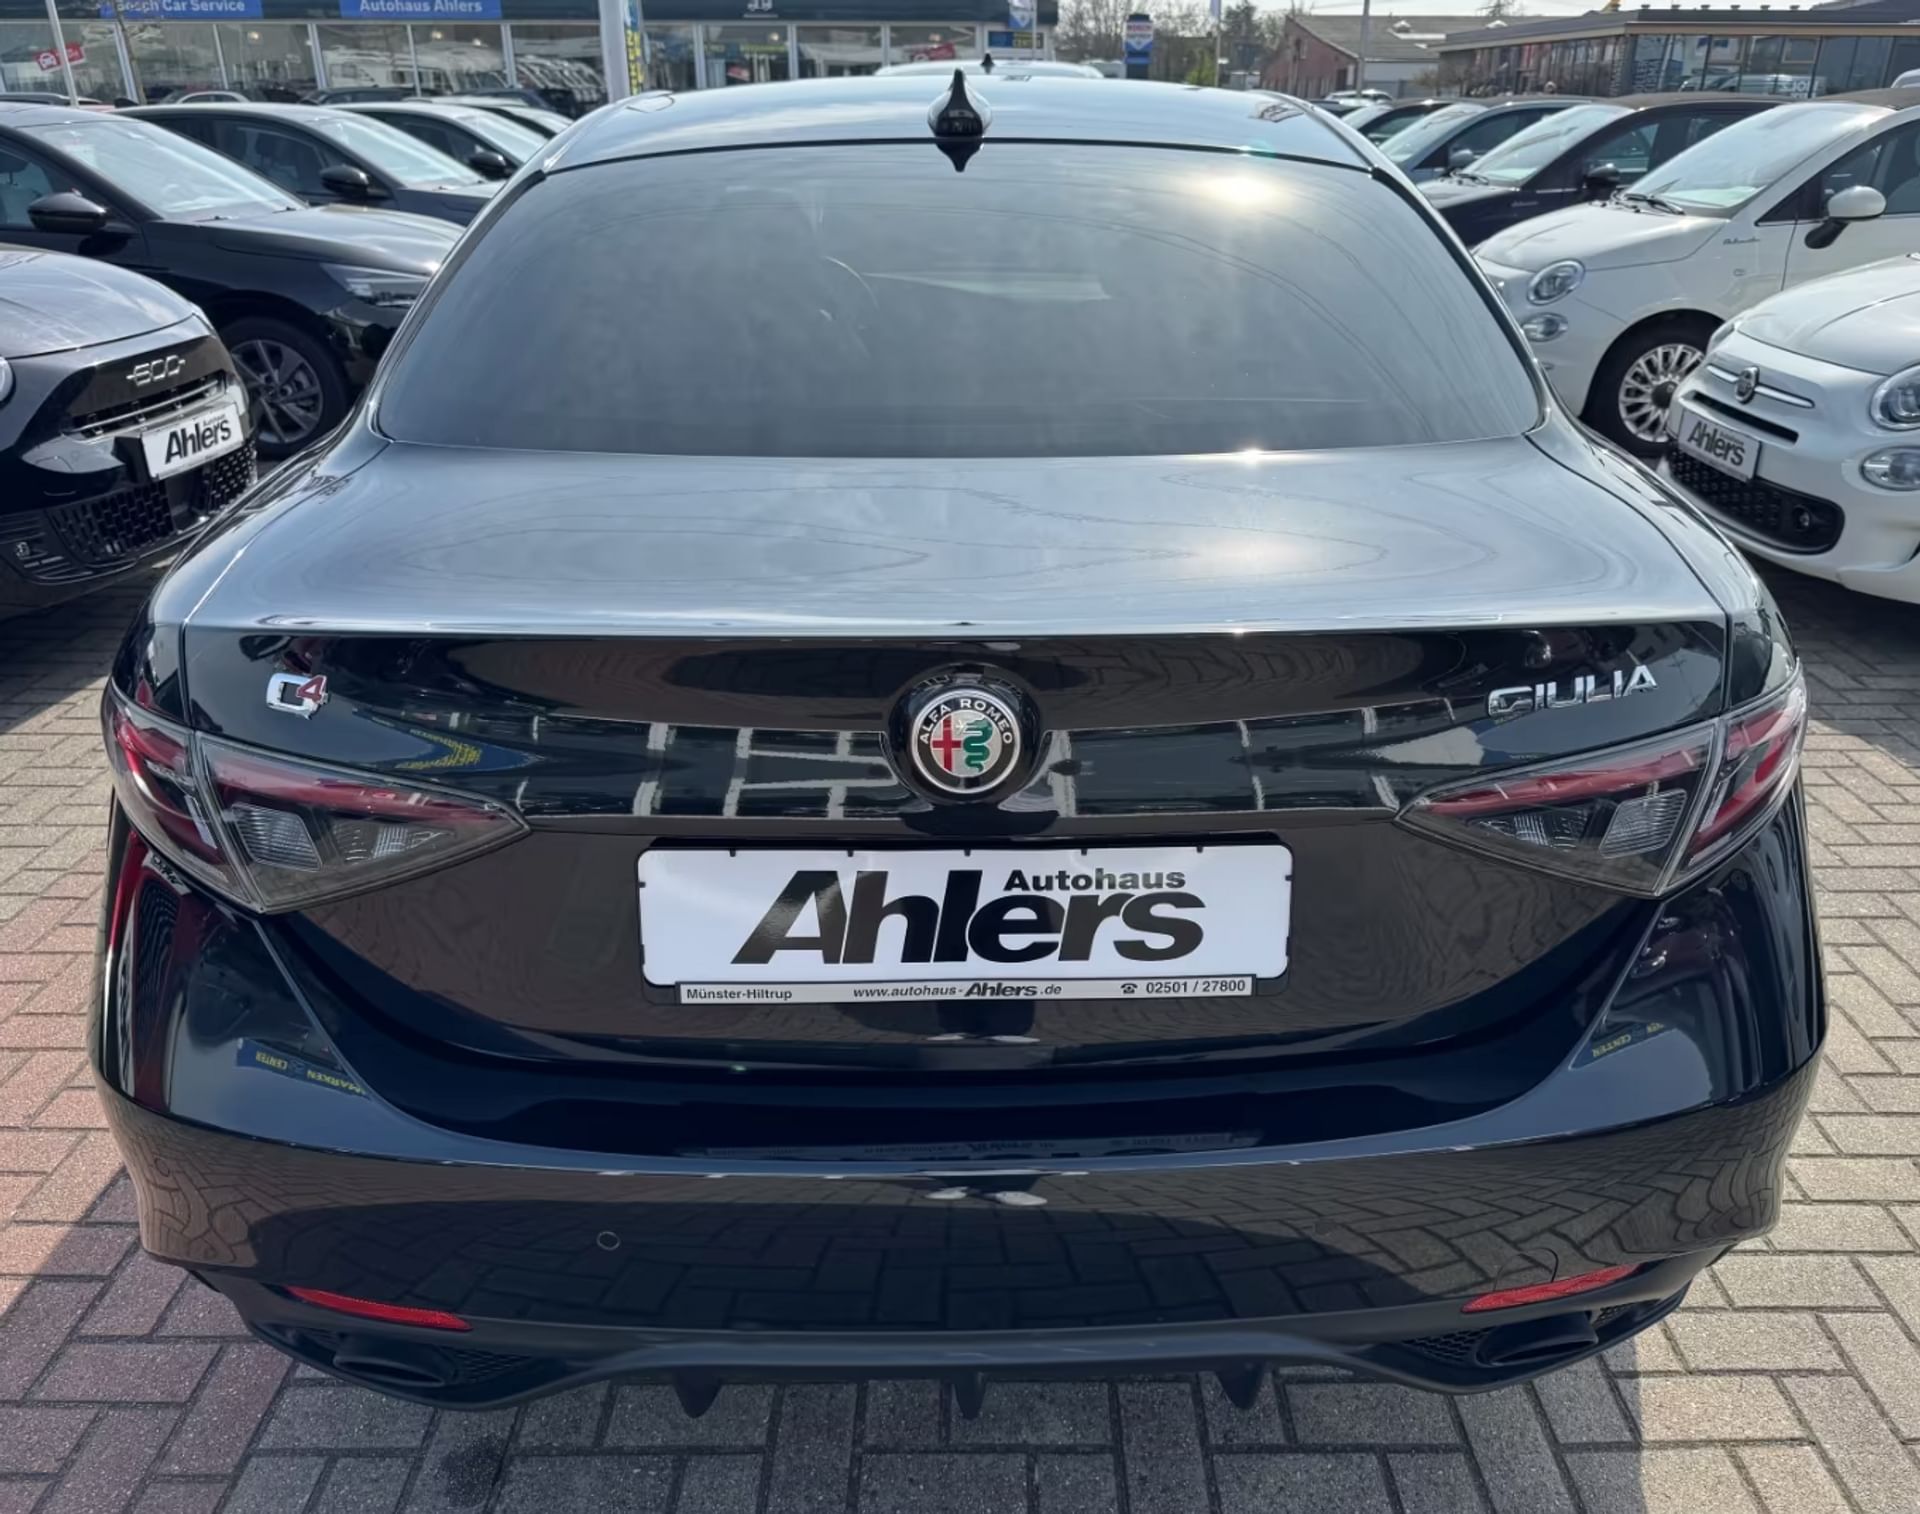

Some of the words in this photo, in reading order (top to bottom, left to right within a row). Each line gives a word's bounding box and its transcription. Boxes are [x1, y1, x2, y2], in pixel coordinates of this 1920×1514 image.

[162, 0, 190, 11] Car
[192, 0, 245, 11] Service
[360, 0, 431, 12] Autohaus
[434, 0, 483, 12] Ahlers
[165, 420, 231, 464] Ahlers
[1687, 421, 1745, 466] Ahlers
[1488, 665, 1657, 717] GIULIA
[919, 704, 952, 745] ALFA
[959, 698, 1013, 744] ROMEO
[1003, 868, 1186, 892] Autohaus
[730, 869, 1206, 964] Ahlers
[686, 988, 792, 1001] Münster-Hiltrup
[1146, 981, 1187, 994] 02501
[1202, 979, 1246, 992] 27800
